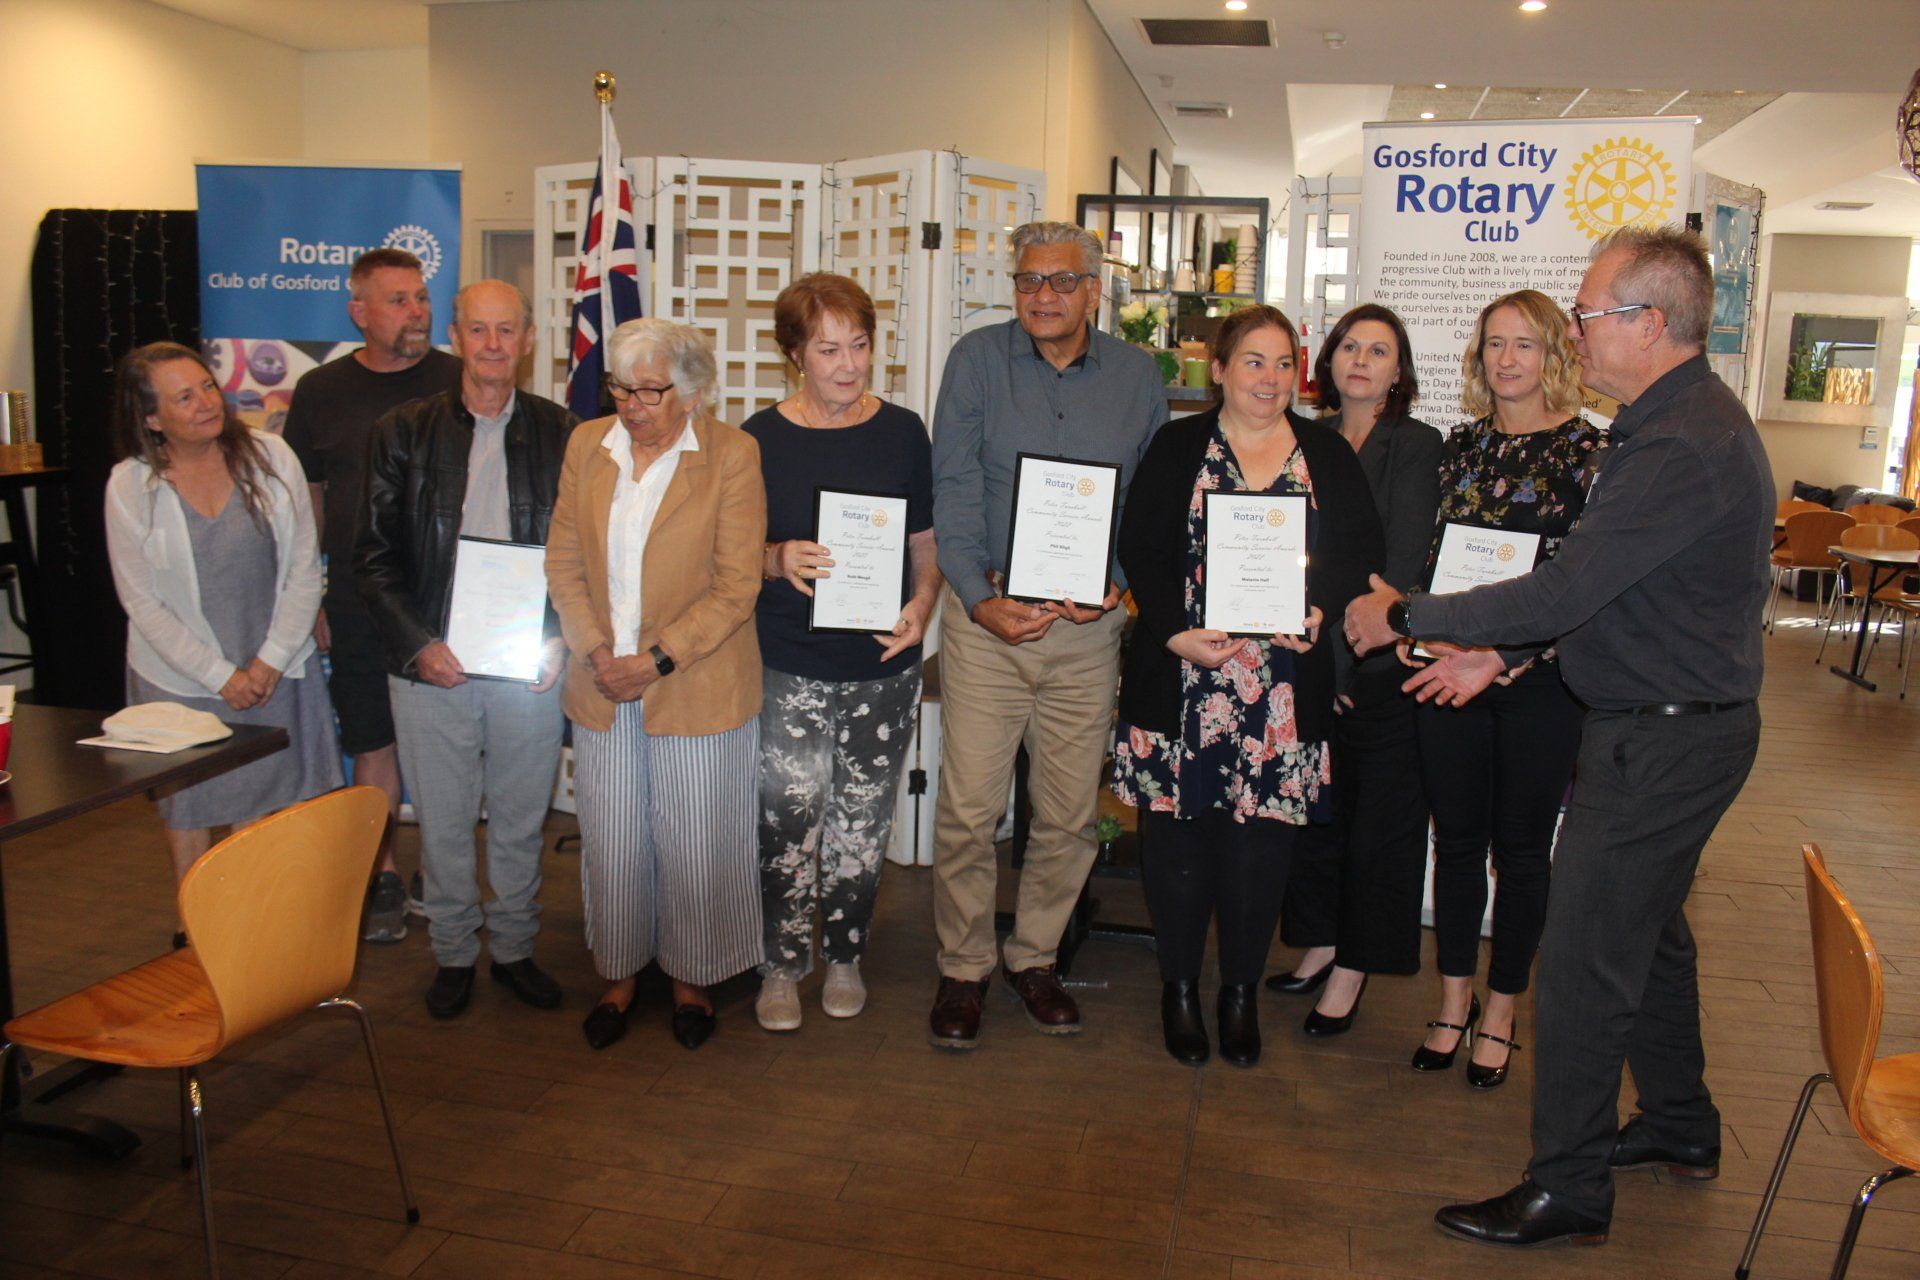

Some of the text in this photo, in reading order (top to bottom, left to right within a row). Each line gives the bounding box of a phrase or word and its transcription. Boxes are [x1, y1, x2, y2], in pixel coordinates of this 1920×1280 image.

[1373, 141, 1558, 173] Gosford City
[1599, 148, 1646, 162] ROTARY
[1396, 174, 1556, 225] Rotary
[1464, 220, 1520, 242] Club
[279, 237, 375, 266] Rotar
[1383, 251, 1591, 264] Founded in June 2008, we are a contem
[1381, 264, 1440, 276] progressive
[1442, 265, 1465, 275] Club
[1468, 266, 1491, 275] with
[1494, 267, 1500, 276] a
[1503, 266, 1530, 278] lively
[1533, 267, 1552, 276] mix
[1555, 267, 1568, 277] of
[207, 272, 245, 289] Club
[249, 273, 268, 289] of
[271, 274, 341, 291] Gosford
[1380, 276, 1396, 287] the
[1398, 278, 1460, 290] community,
[1462, 278, 1506, 289] business
[1509, 280, 1529, 289] and
[1532, 280, 1565, 291] public
[1373, 289, 1390, 299] We
[1392, 290, 1419, 301] pride
[1421, 291, 1470, 301] ourselves
[1472, 293, 1486, 301] on
[1401, 303, 1450, 314] ourselves
[1452, 305, 1463, 314] as
[1466, 304, 1482, 314] bei
[1401, 316, 1420, 327] gral
[1422, 317, 1444, 327] part
[1446, 316, 1458, 327] of
[1415, 351, 1450, 362] United
[1415, 365, 1457, 377] Hygiene
[1432, 378, 1452, 390] Day
[1433, 390, 1462, 401] Coast
[1409, 402, 1479, 417] erriwa Droug
[1045, 477, 1075, 491] Rotary
[842, 510, 870, 522] Rotary
[1233, 511, 1265, 523] Rotary
[1465, 542, 1495, 556] Rotary
